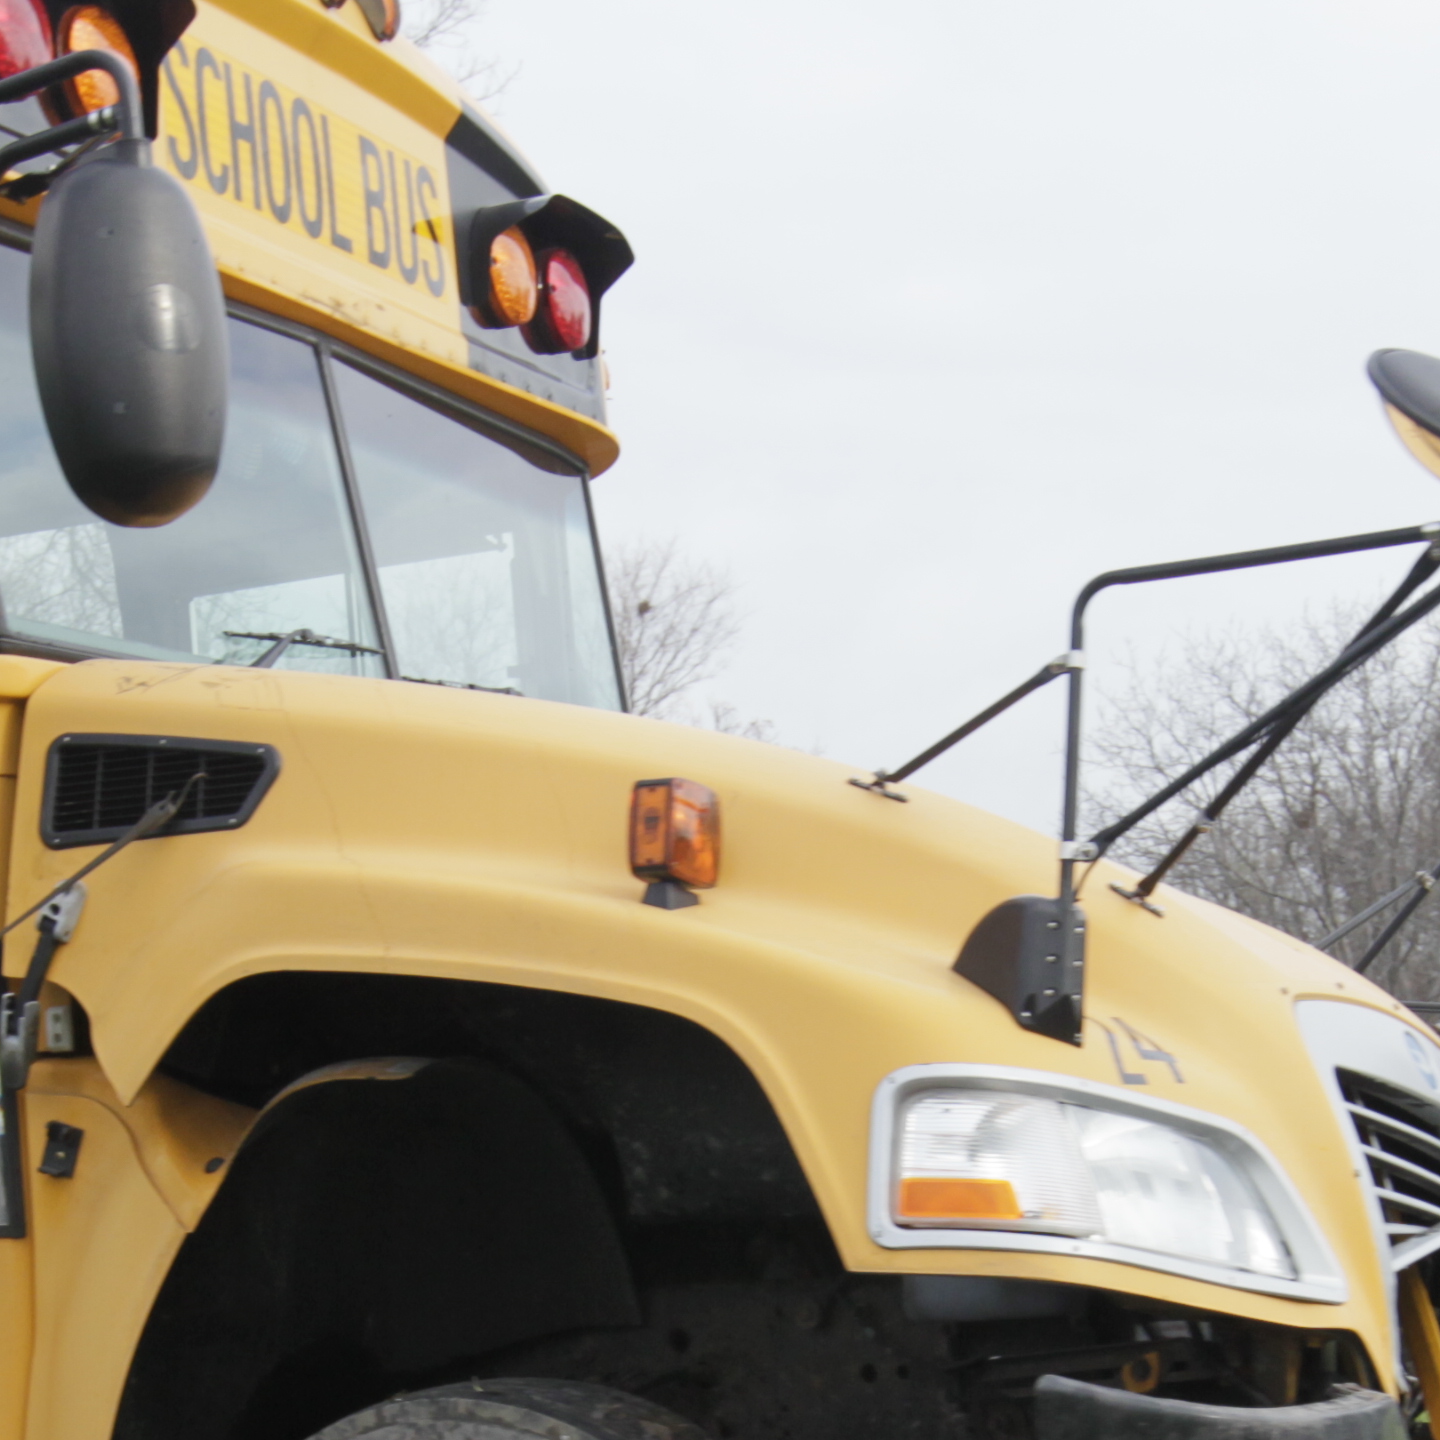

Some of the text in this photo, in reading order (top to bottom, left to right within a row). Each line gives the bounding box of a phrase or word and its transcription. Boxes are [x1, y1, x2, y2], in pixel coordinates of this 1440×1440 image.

[162, 38, 446, 298] SCHOOL BUS
[1081, 1015, 1187, 1086] 24
